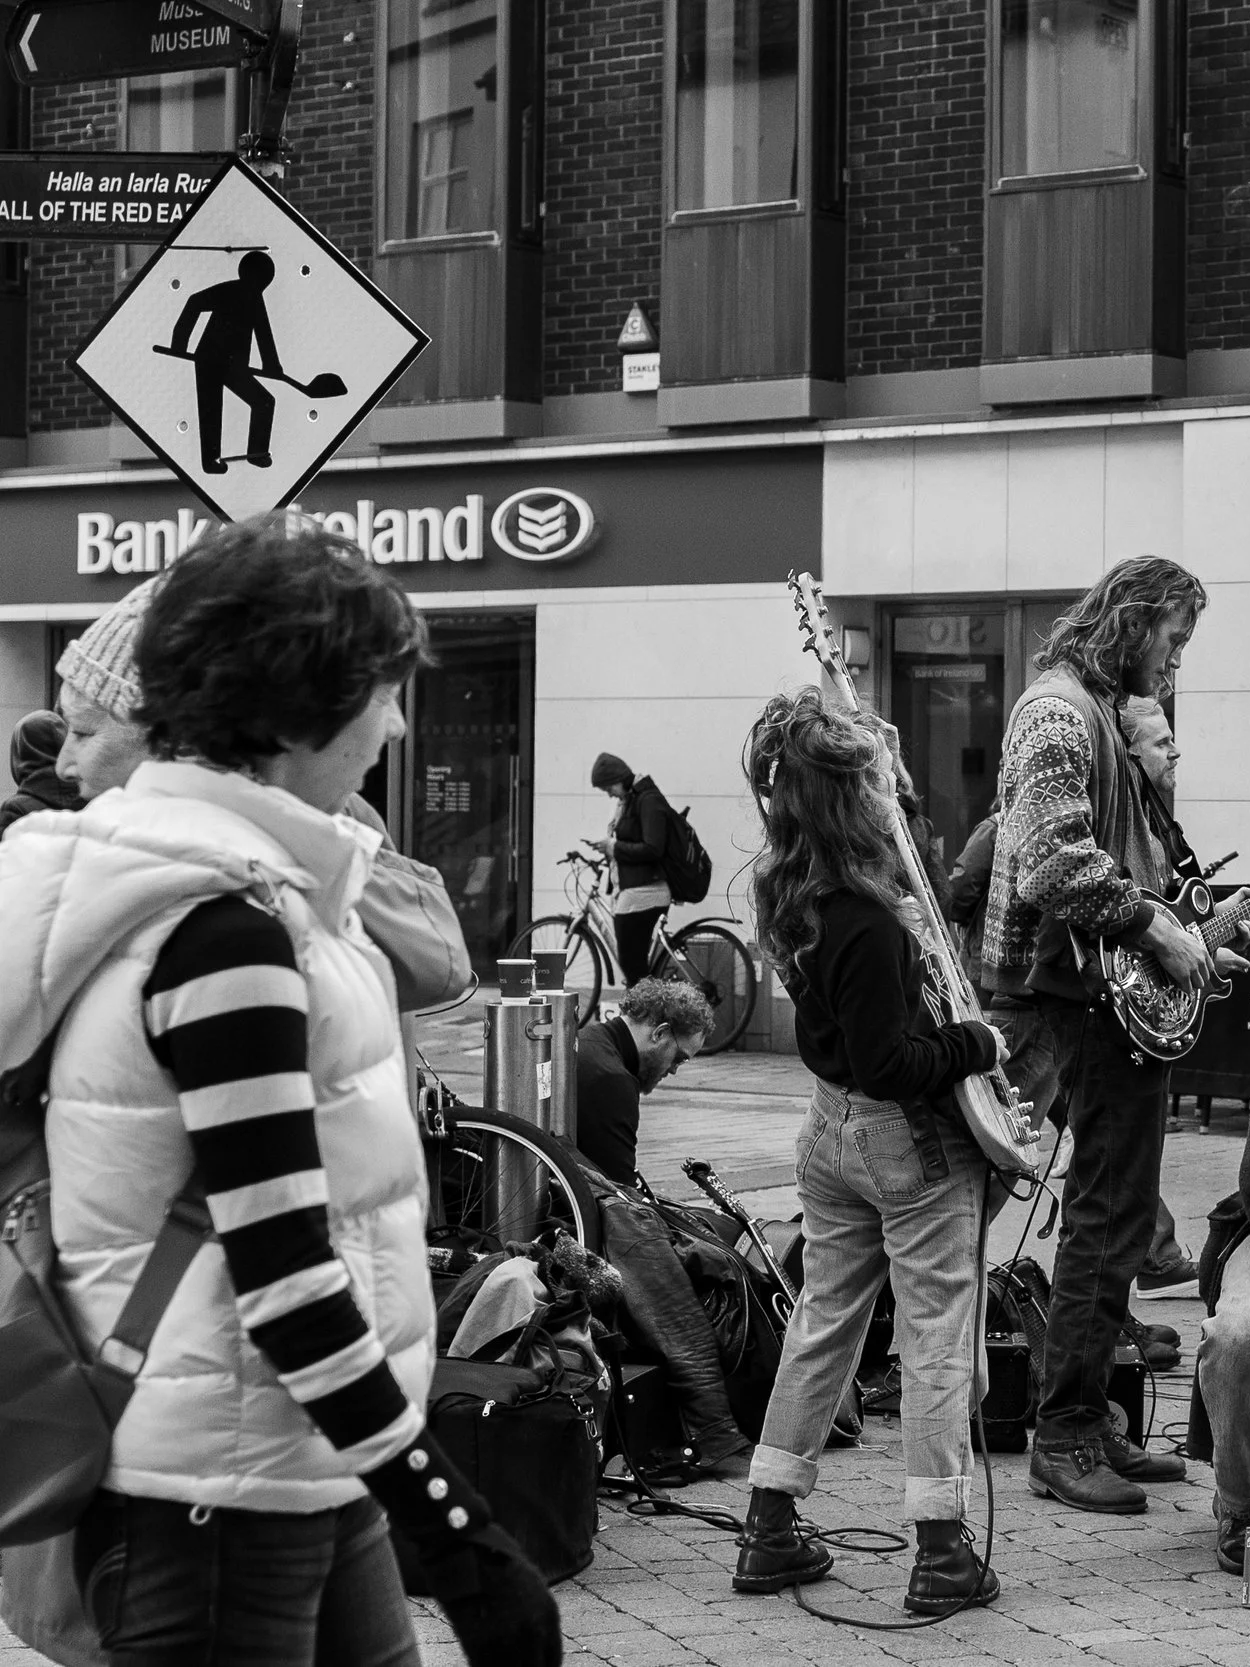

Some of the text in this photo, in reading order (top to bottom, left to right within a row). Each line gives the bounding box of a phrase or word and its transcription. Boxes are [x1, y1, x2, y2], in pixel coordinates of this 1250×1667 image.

[151, 25, 230, 53] MUSEUM
[47, 171, 93, 192] Halla
[98, 177, 122, 193] an
[127, 172, 169, 193] Iarla
[39, 201, 65, 221] OF
[70, 201, 107, 222] THE
[112, 203, 151, 222] RED
